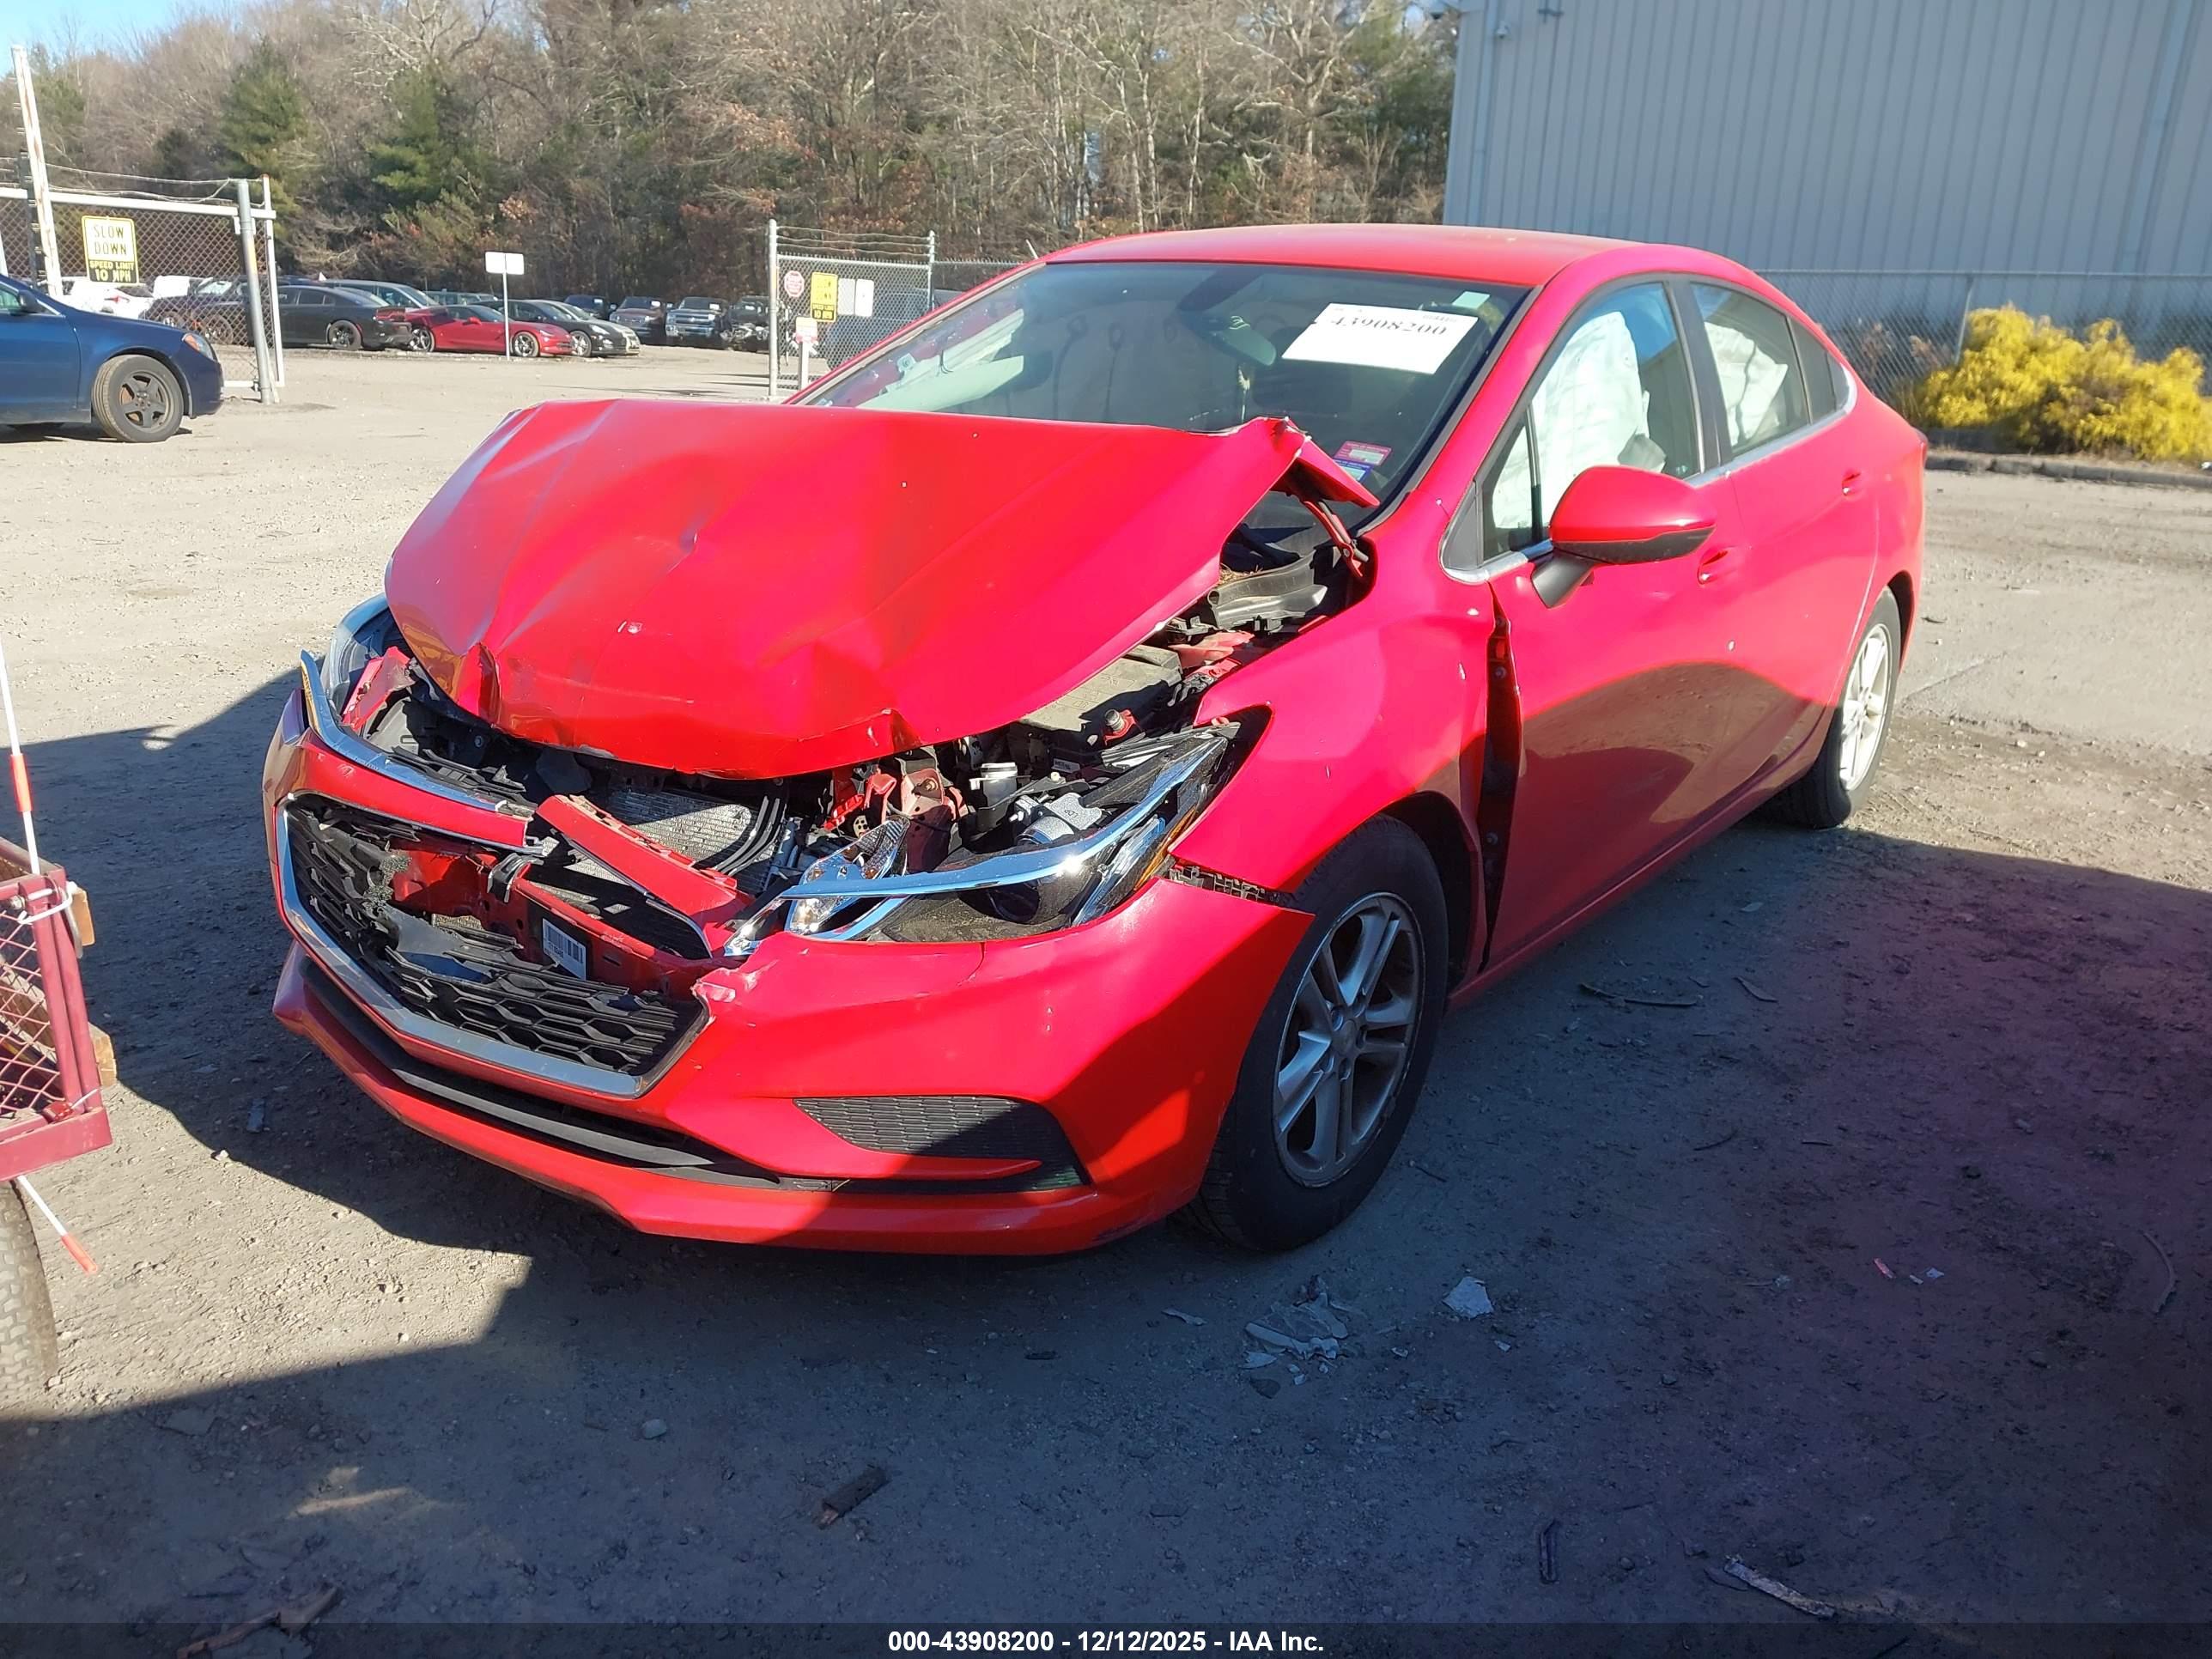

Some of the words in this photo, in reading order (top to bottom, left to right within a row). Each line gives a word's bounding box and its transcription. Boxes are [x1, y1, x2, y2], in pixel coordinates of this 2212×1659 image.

[94, 225, 124, 238] SLOW
[94, 241, 126, 255] DOWN
[89, 260, 113, 270] SPEED
[115, 261, 134, 270] LIMIT
[94, 269, 108, 281] 10
[112, 270, 131, 282] MPH
